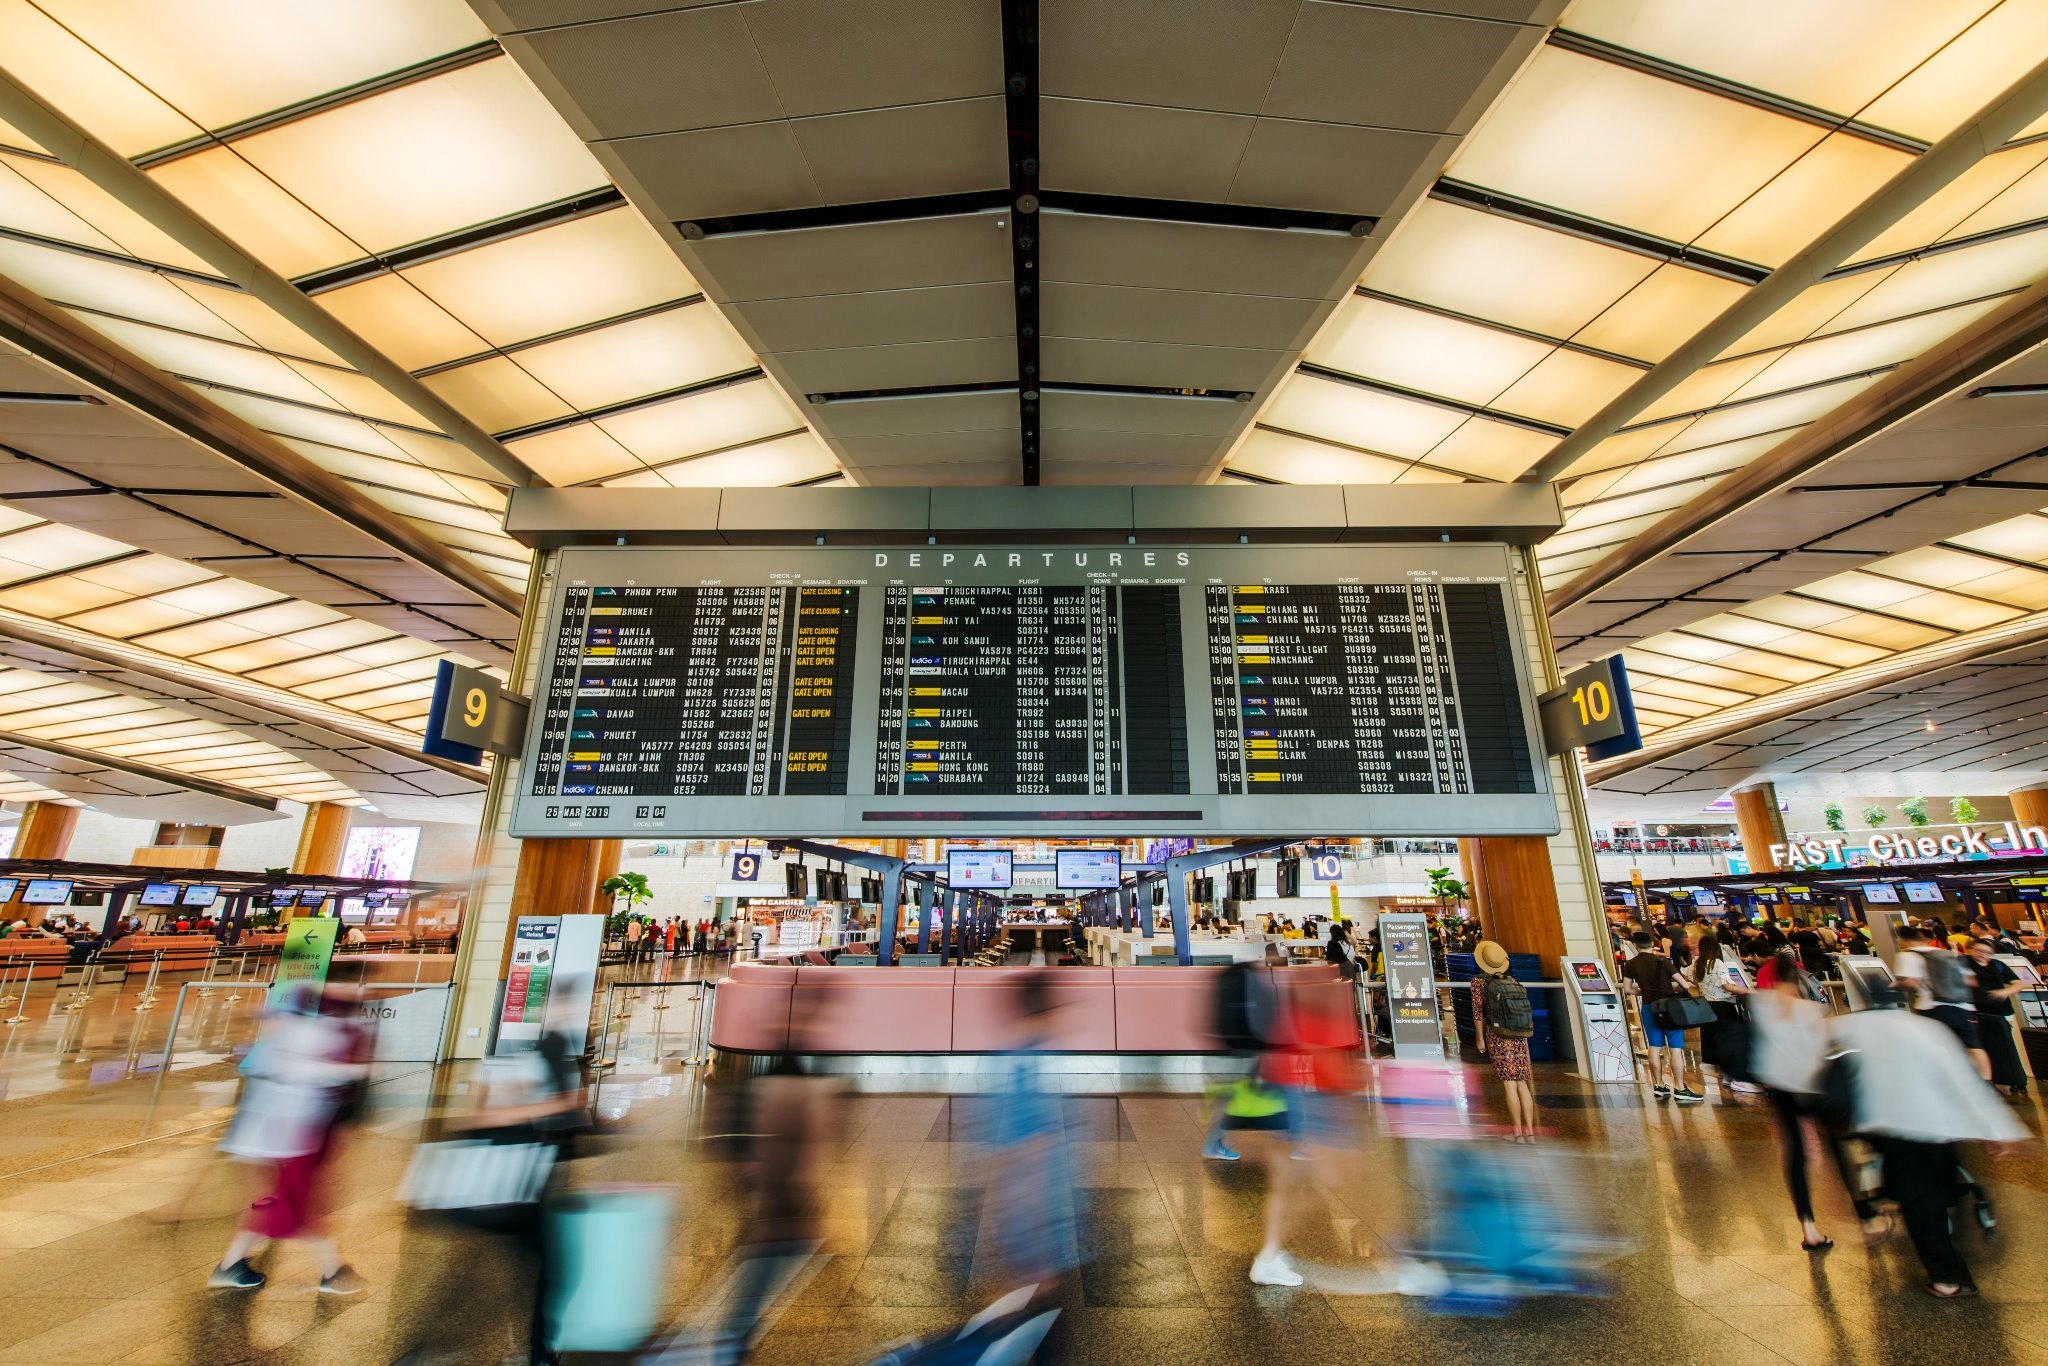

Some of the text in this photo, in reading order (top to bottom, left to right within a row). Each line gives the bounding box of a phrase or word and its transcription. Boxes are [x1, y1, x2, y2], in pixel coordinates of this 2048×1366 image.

[875, 553, 1190, 567] DEPARTURES
[803, 588, 841, 596] GATE CLOSING
[912, 657, 932, 665] IndiGo
[464, 688, 487, 727] 9
[1572, 681, 1610, 726] 10
[1769, 822, 2048, 867] FAST Check-In
[738, 857, 754, 878] 9
[1313, 856, 1340, 876] 10
[1636, 887, 1646, 921] Assistance
[303, 962, 320, 970] link
